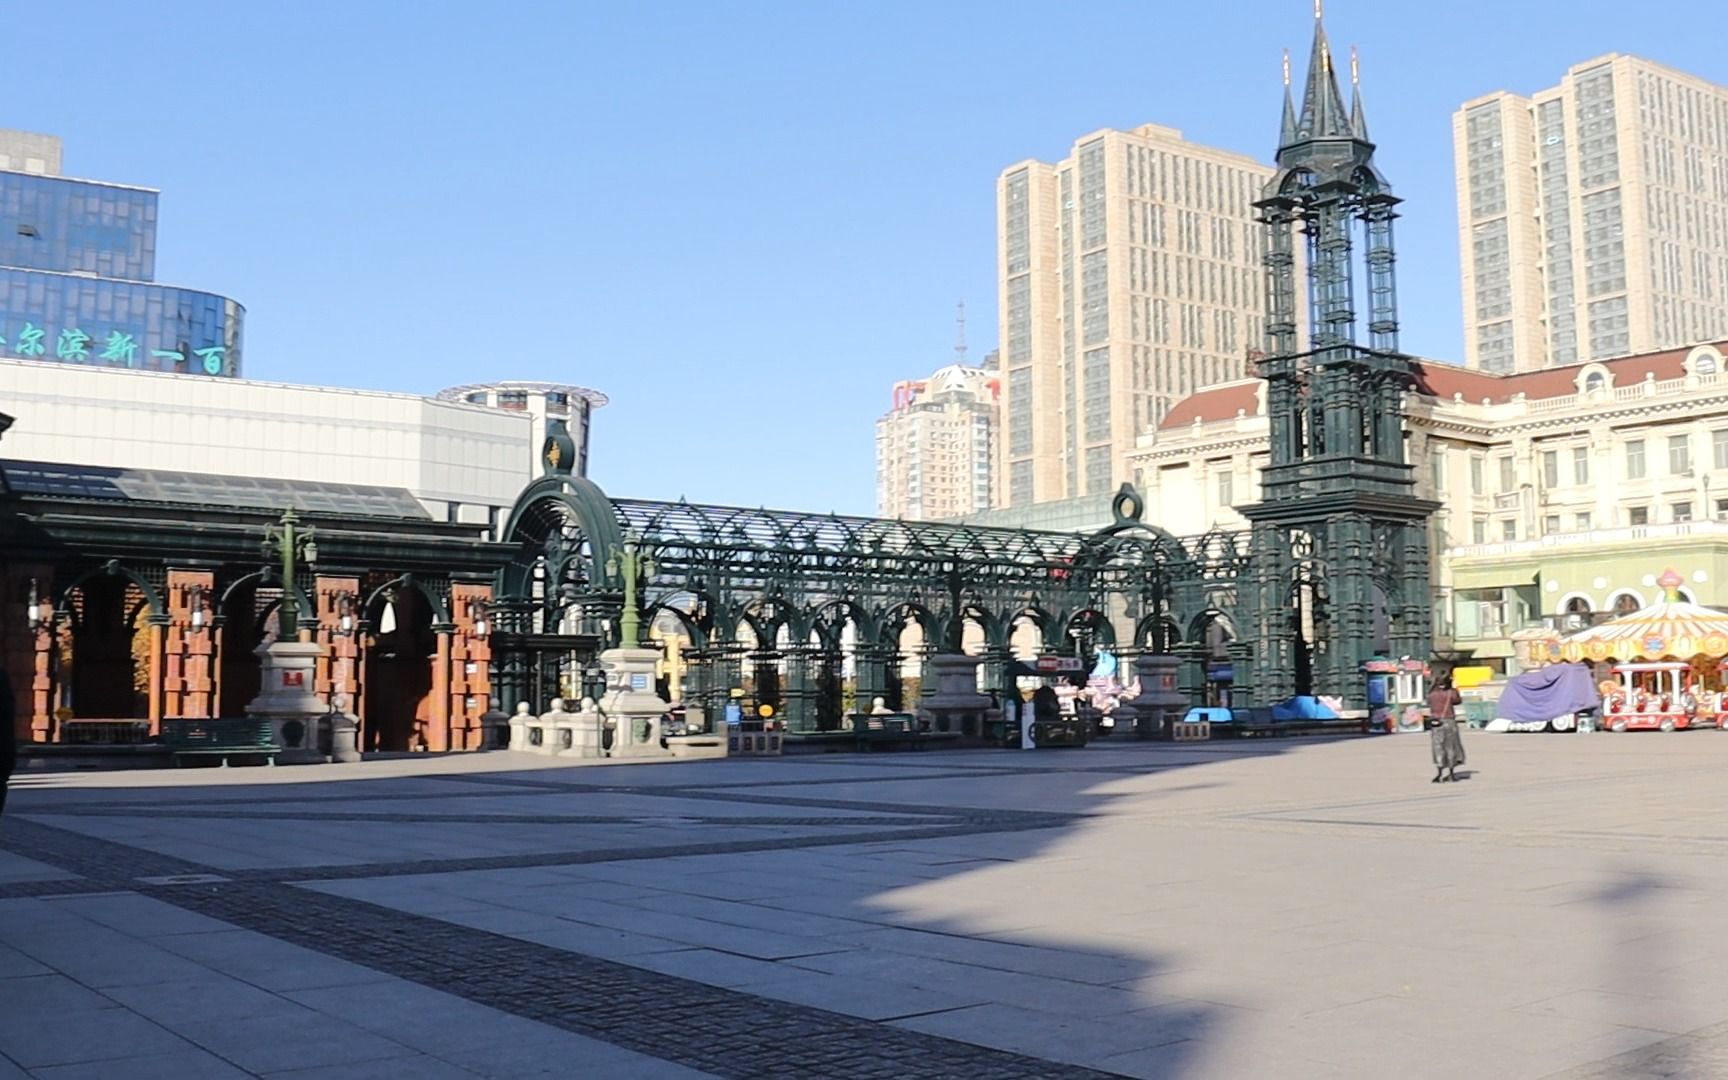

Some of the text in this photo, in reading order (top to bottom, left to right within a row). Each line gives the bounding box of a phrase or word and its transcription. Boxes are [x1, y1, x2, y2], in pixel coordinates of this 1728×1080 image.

[0, 321, 226, 375] 尔滨新一百
